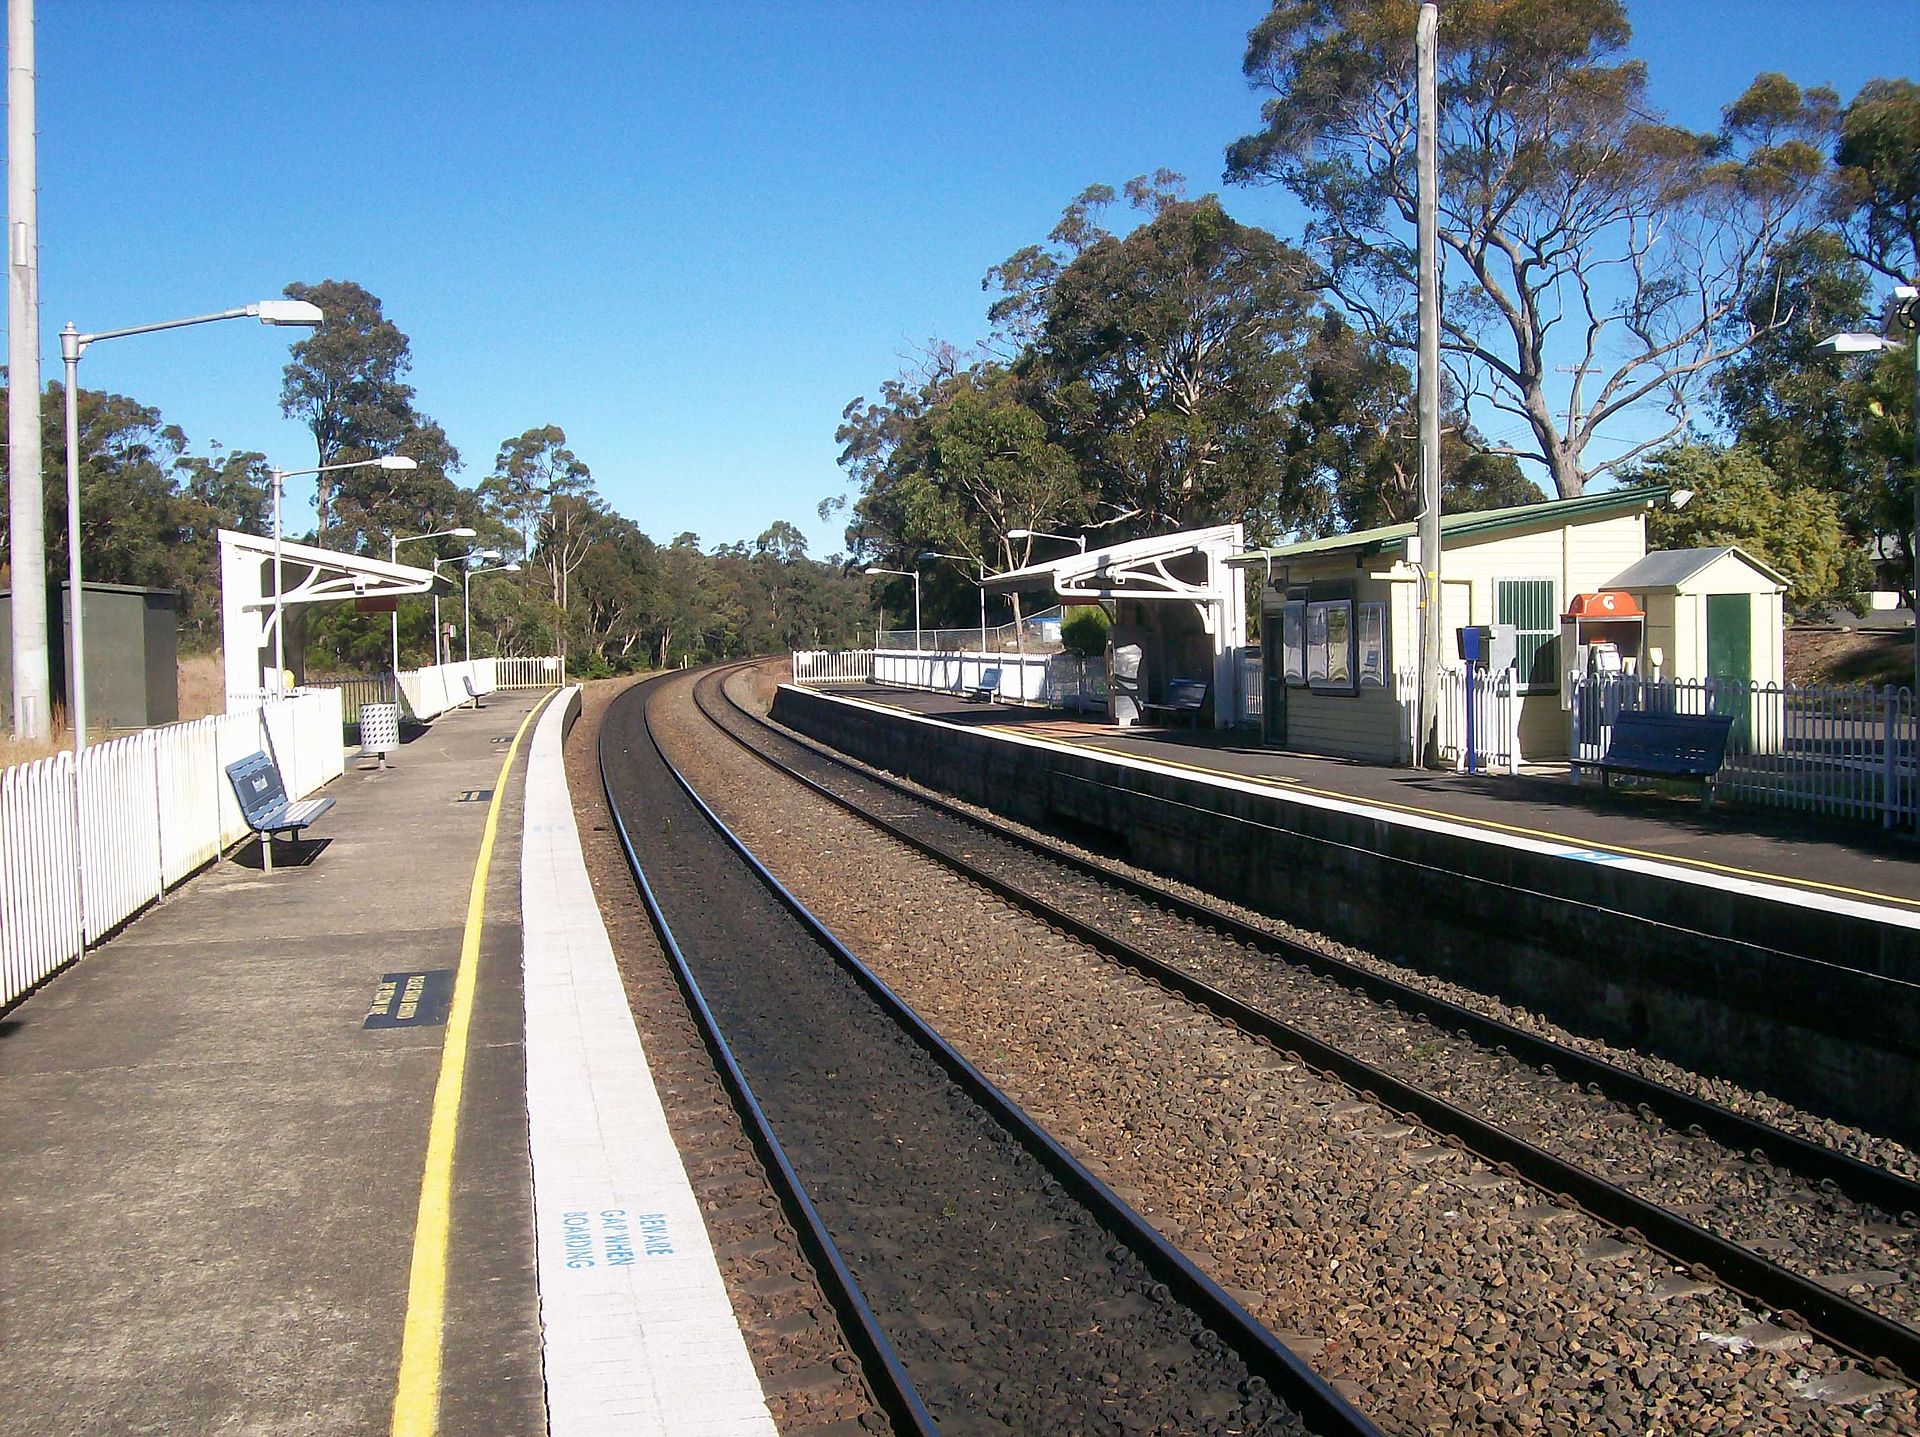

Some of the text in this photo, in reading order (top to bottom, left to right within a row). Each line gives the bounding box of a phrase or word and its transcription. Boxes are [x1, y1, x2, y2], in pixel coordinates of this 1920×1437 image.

[562, 1211, 595, 1269] BOARDING
[600, 1209, 635, 1267] GAP WHEN
[639, 1213, 674, 1256] BEWARE
